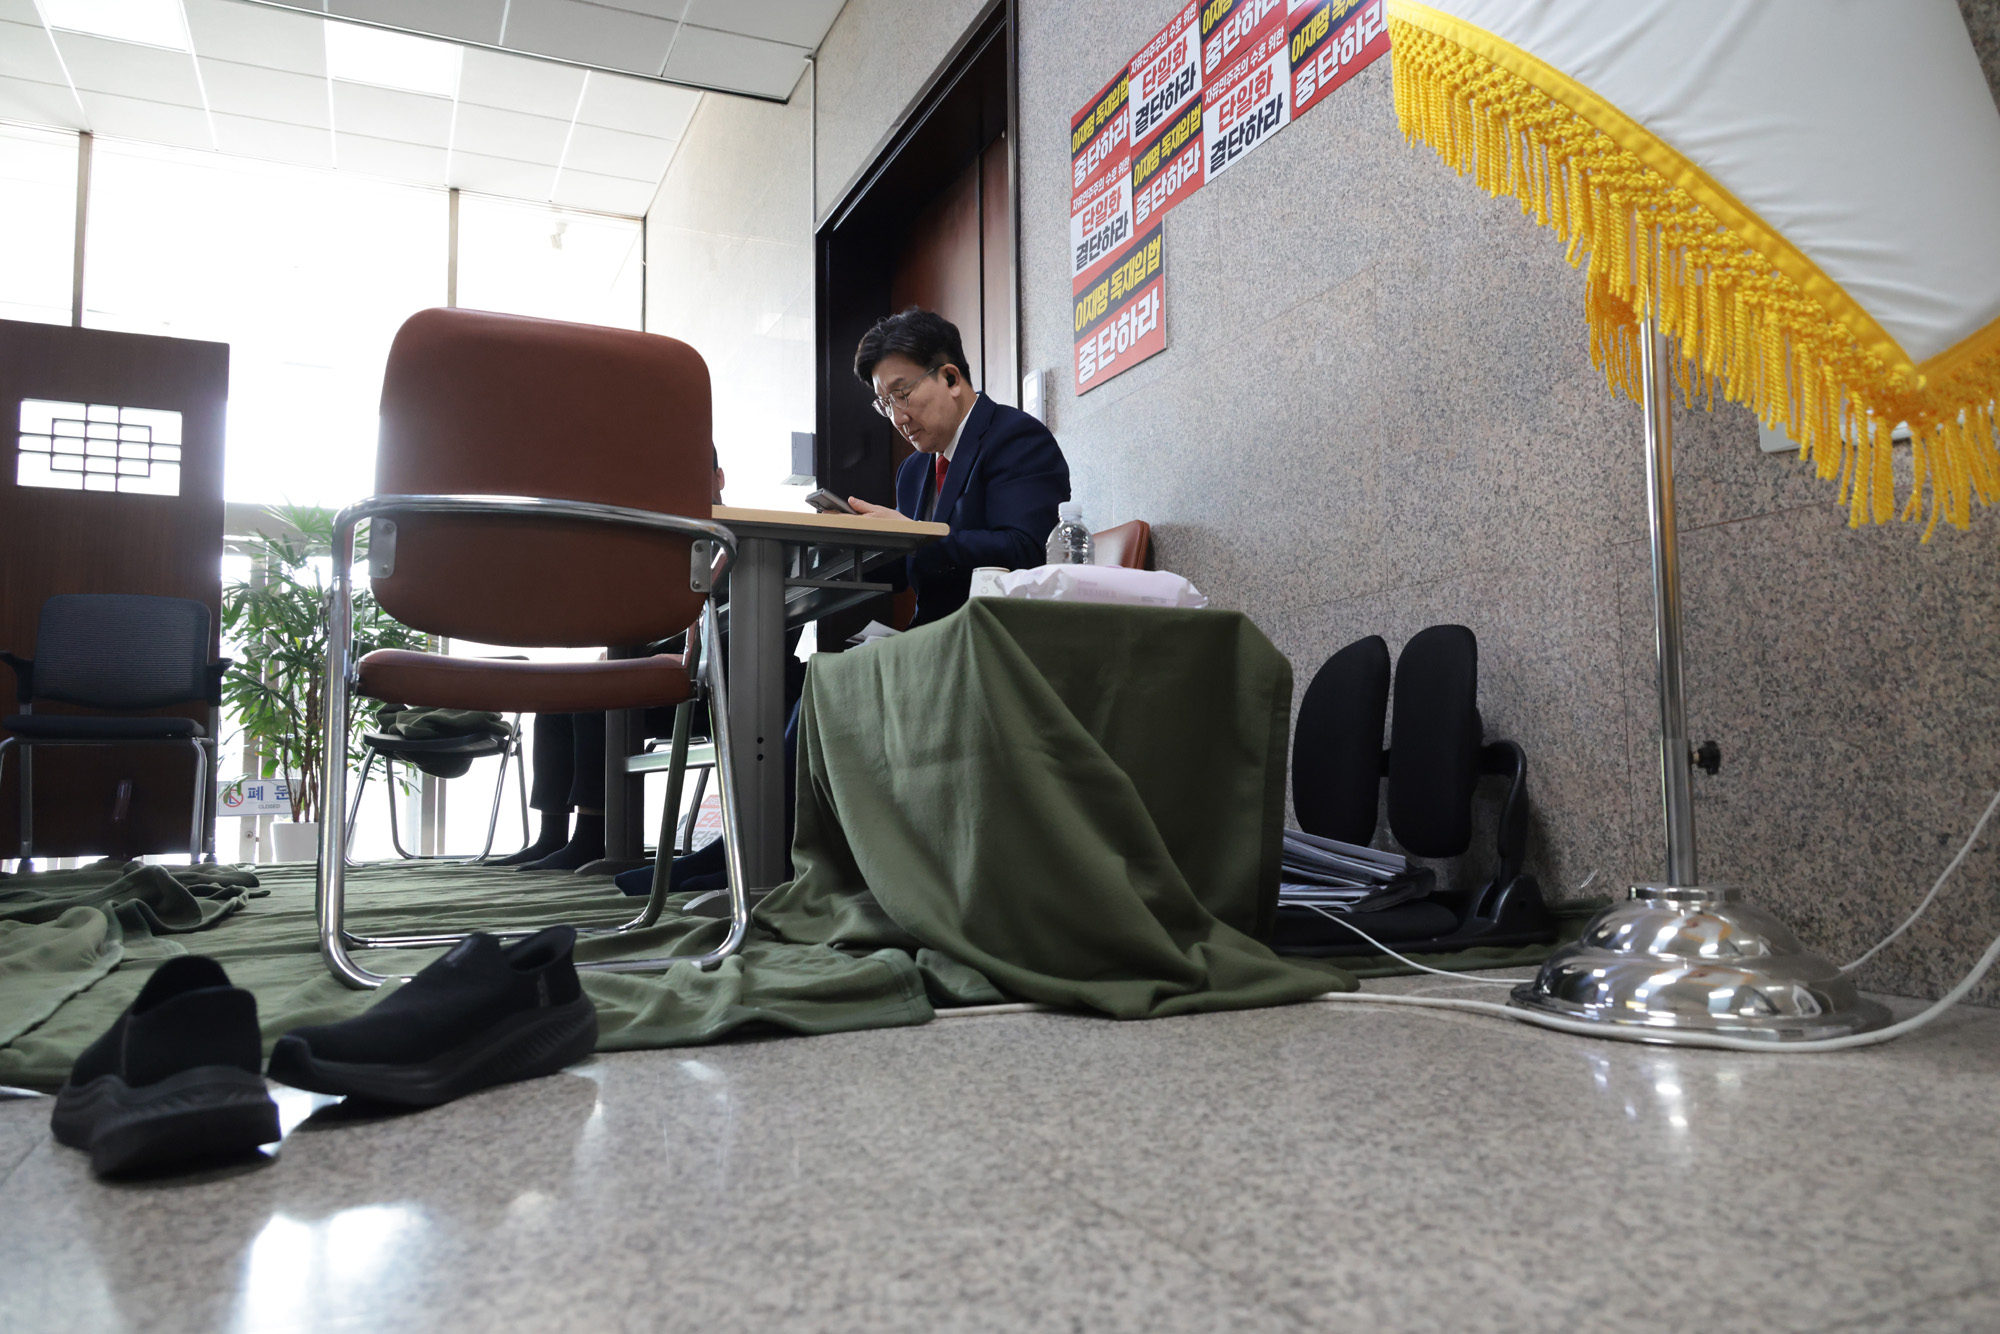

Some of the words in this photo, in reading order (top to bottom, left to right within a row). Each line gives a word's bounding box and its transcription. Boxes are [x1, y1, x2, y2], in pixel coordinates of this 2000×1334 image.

[1130, 30, 1168, 75] 자유민주주의
[1169, 16, 1182, 39] 수호
[1183, 1, 1197, 25] 위한
[1142, 35, 1188, 101] 단일화
[1204, 56, 1250, 105] 자유민주주의
[1250, 42, 1267, 67] 수호
[1268, 25, 1285, 53] 위한
[1292, 3, 1330, 63] 이재명
[1072, 111, 1095, 154] 이재명
[1096, 73, 1129, 127] 독재입법
[1135, 61, 1197, 138] 결단하라
[1210, 92, 1283, 174] 결단하라
[1218, 63, 1274, 134] 단일화
[1074, 108, 1129, 189] 중단하라
[1105, 166, 1117, 187] 수호
[1118, 155, 1130, 175] 위한
[1134, 142, 1160, 187] 이재명
[1161, 102, 1202, 159] 독재입법
[1135, 141, 1201, 226] 중단하라
[1076, 210, 1128, 271] 결단하라
[1082, 185, 1122, 238] 단일화
[1075, 278, 1109, 332] 이재명
[1110, 234, 1162, 301] 독재입법
[1078, 286, 1160, 385] 중단하라
